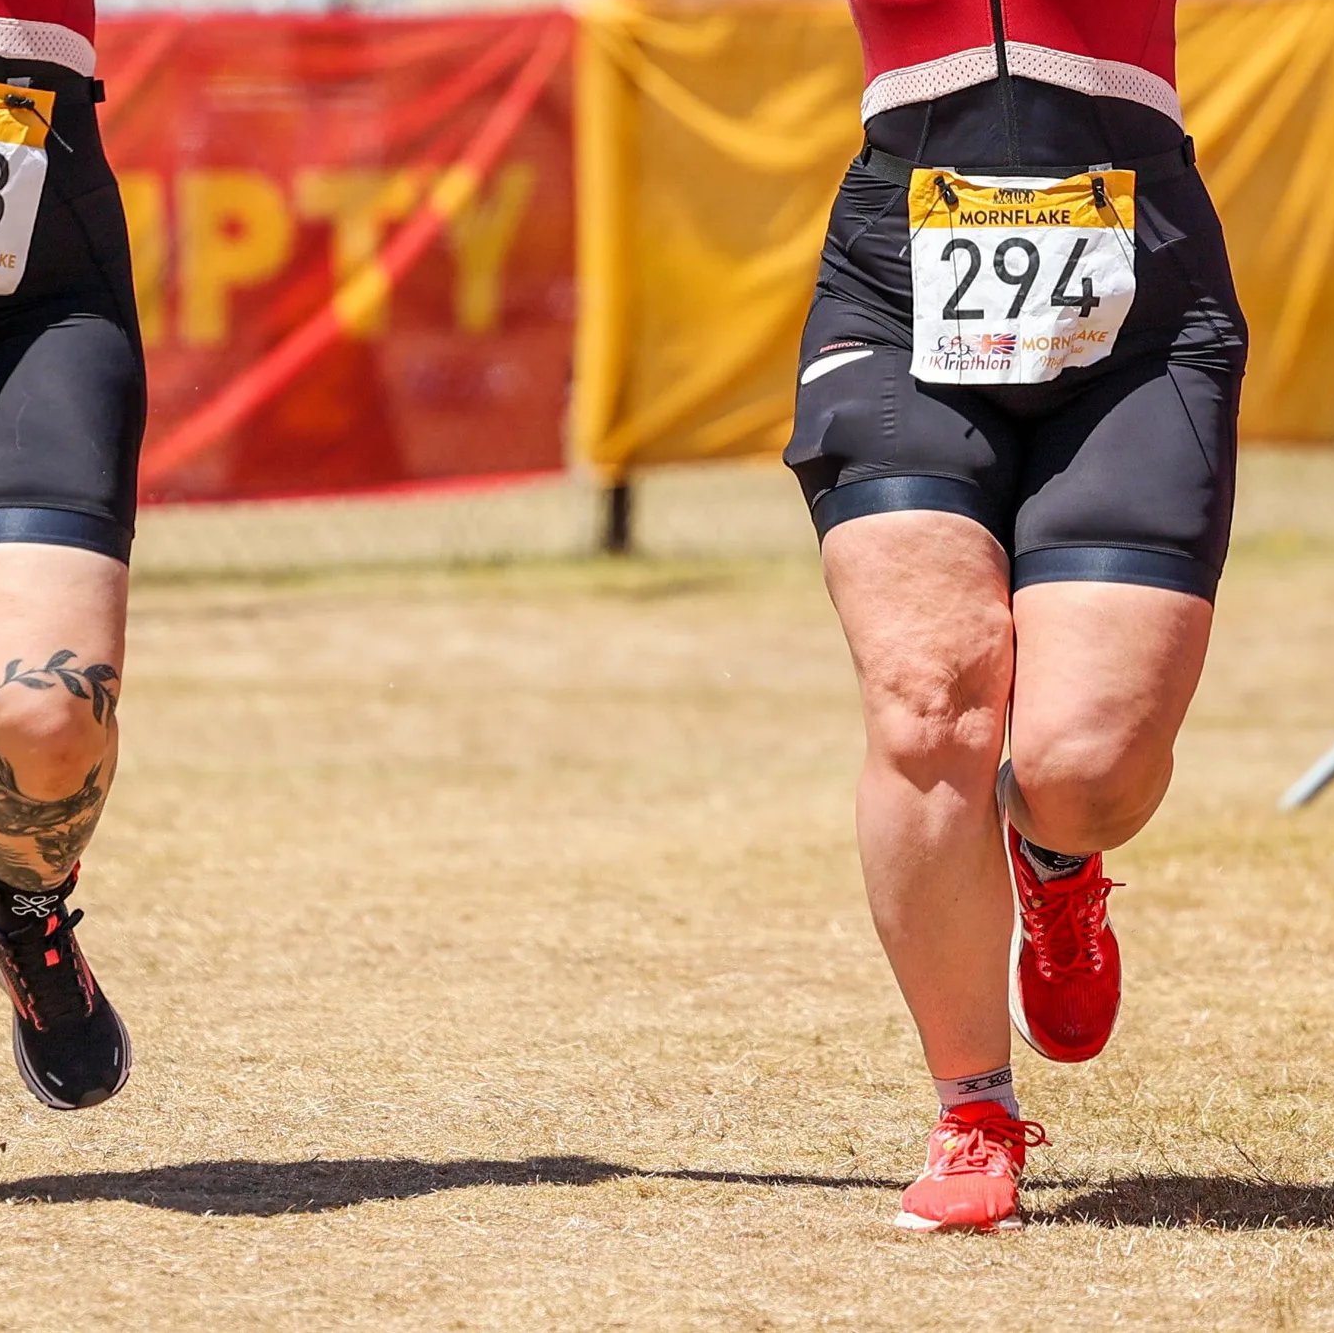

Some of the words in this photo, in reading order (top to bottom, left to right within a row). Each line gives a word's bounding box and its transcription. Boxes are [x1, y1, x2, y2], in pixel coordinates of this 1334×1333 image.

[959, 209, 1071, 226] MORNFLAKE
[939, 237, 1101, 319] 294
[1022, 329, 1109, 351] MORNAKE
